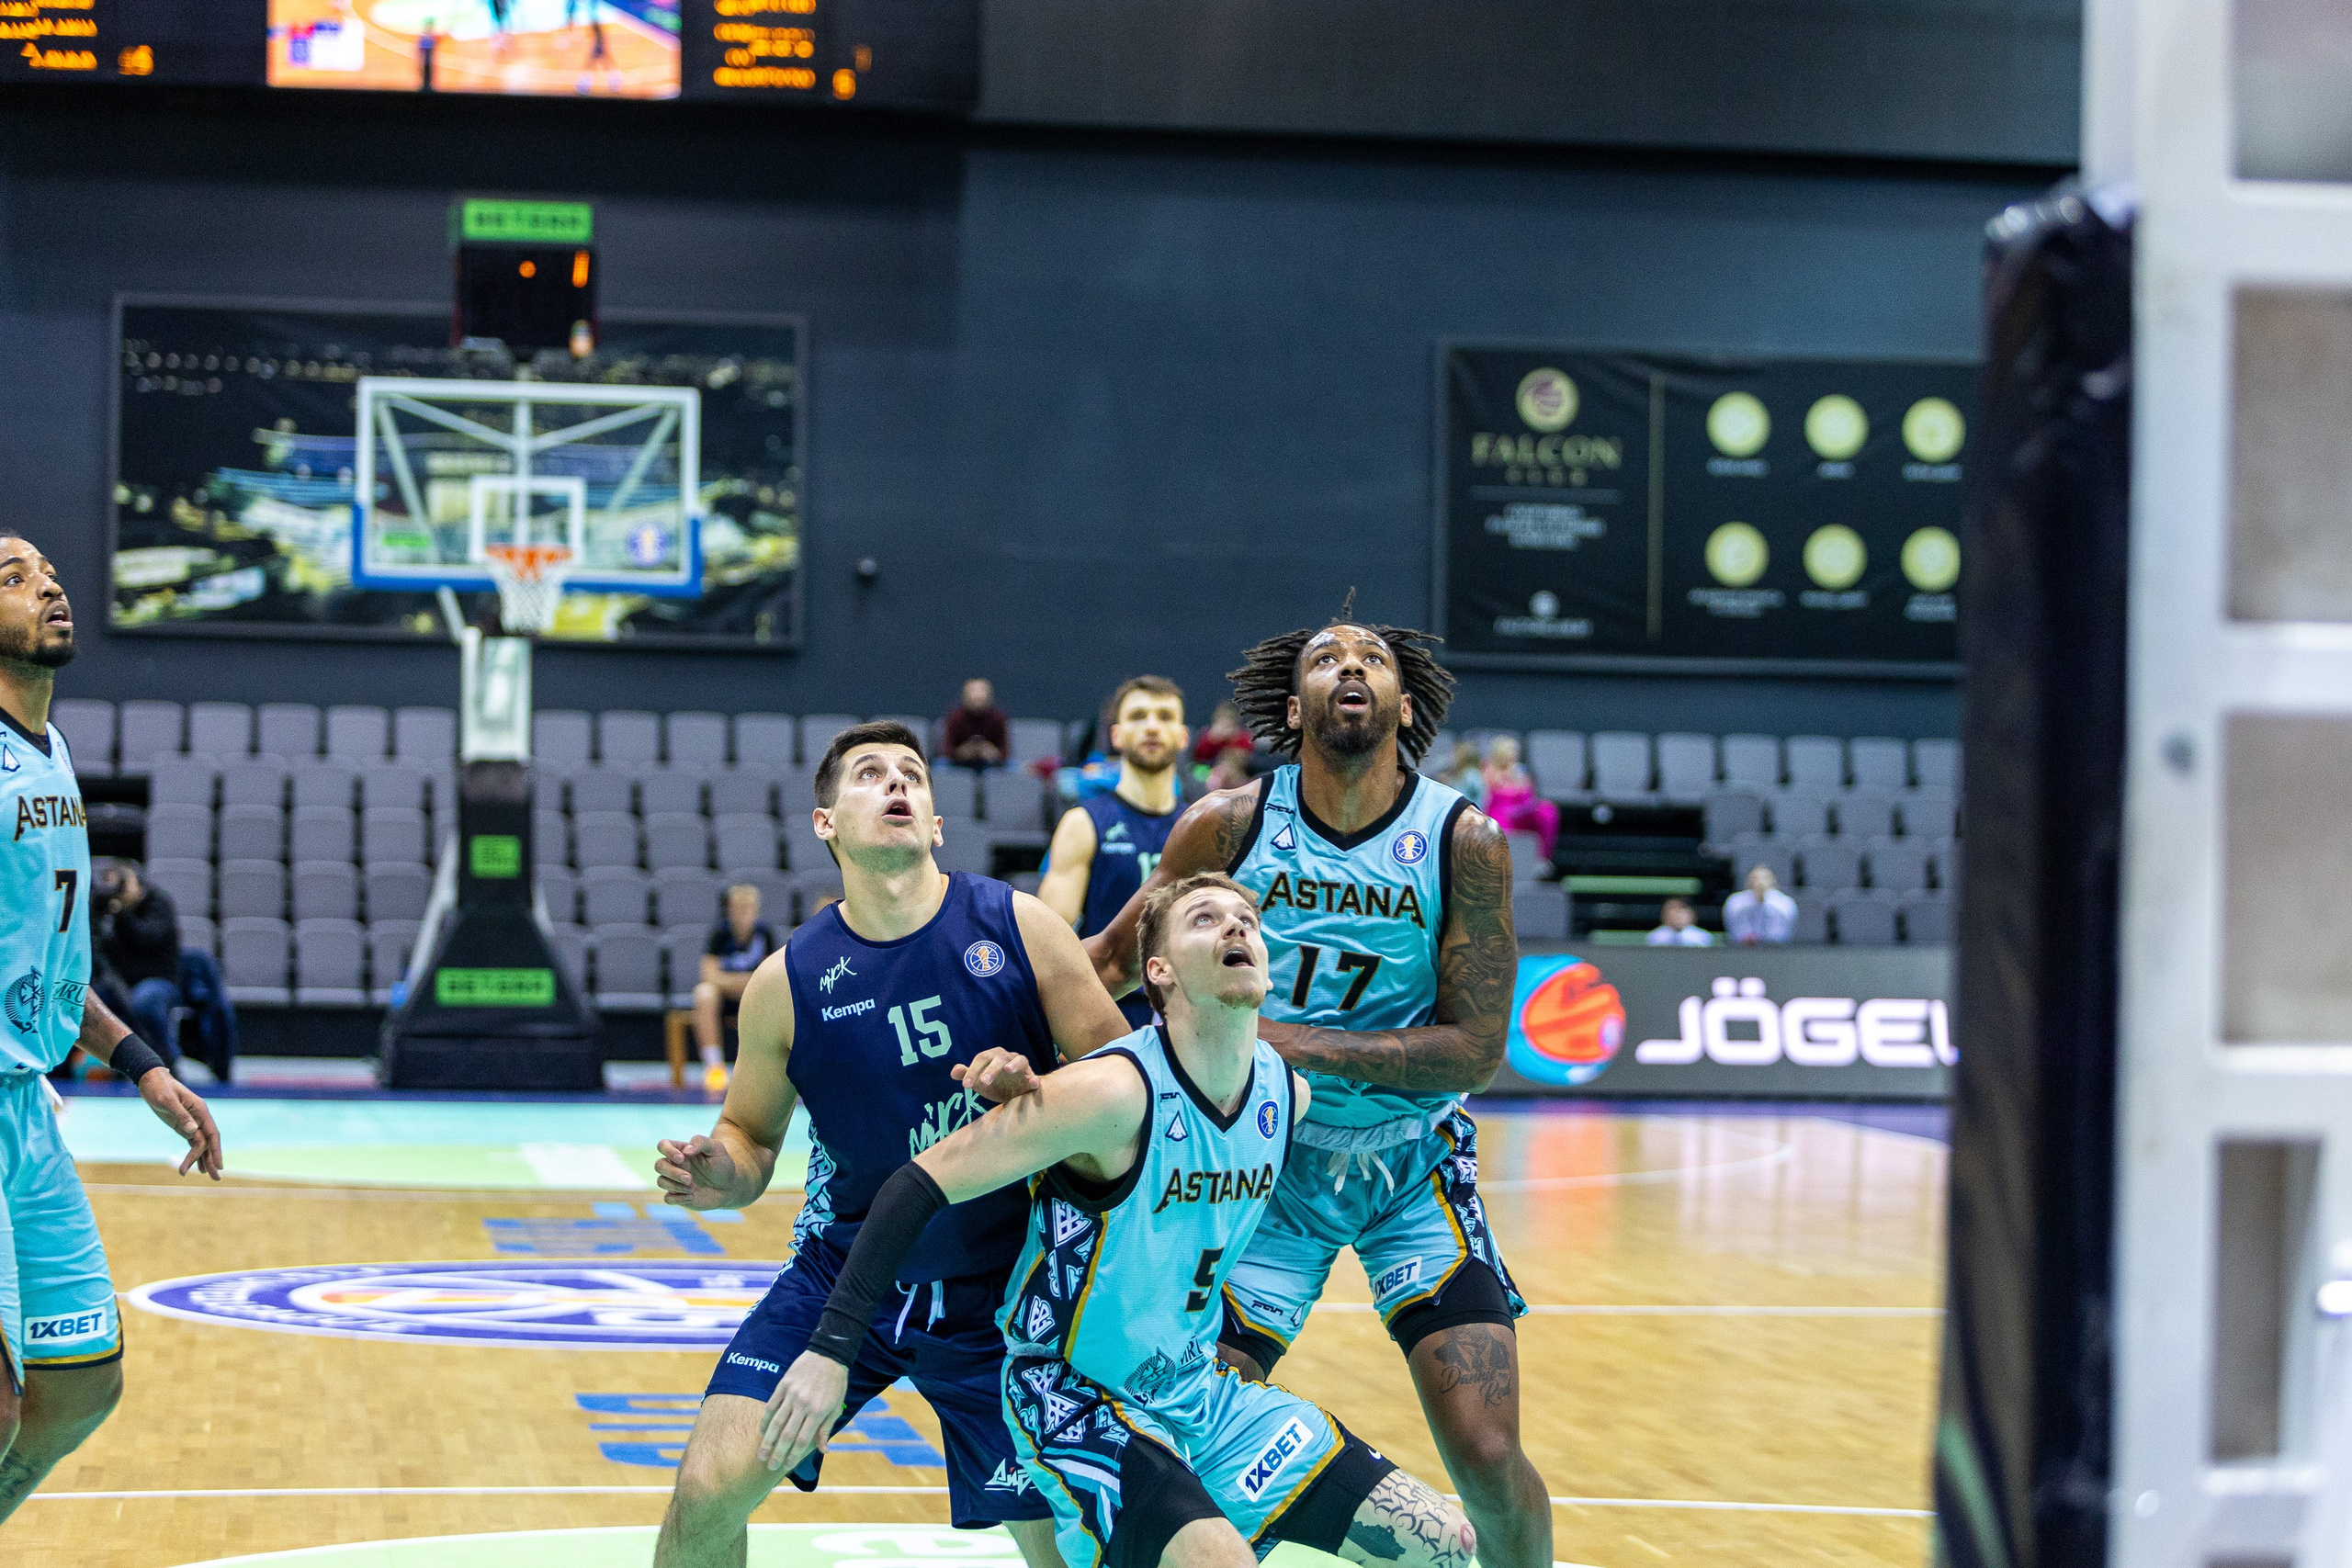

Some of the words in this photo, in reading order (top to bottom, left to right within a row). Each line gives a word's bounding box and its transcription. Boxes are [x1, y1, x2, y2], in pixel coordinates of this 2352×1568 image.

[54, 869, 77, 933] 7
[1261, 871, 1426, 929] ASTANA
[1291, 944, 1383, 1011] 17
[821, 998, 876, 1021] Kempa
[887, 995, 952, 1066] 15
[1152, 1162, 1273, 1214] ASTANA
[30, 1313, 102, 1339] 1XBET
[726, 1351, 780, 1373] Kempa
[1245, 1422, 1307, 1495] 1XBET
